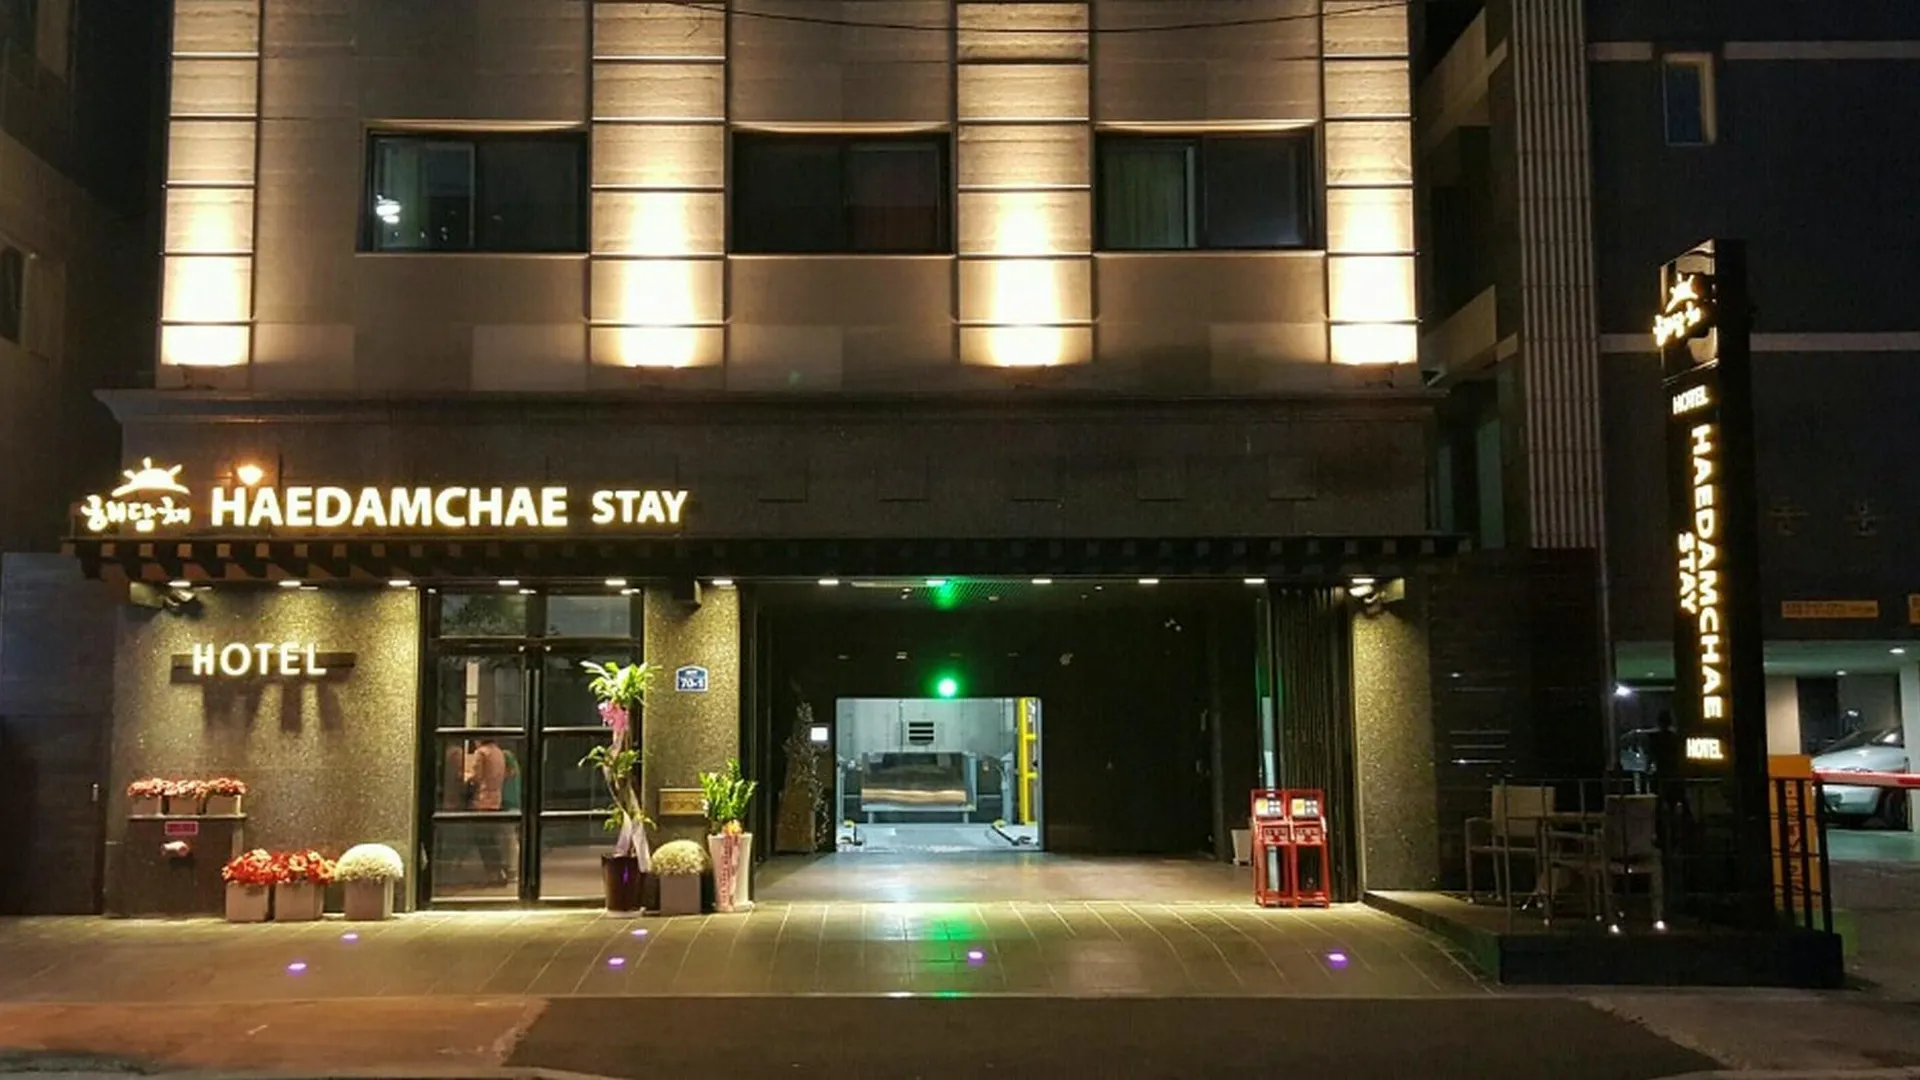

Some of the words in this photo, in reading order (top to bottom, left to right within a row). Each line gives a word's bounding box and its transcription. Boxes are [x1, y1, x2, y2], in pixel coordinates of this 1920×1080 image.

[1673, 385, 1709, 415] HOTEL
[211, 485, 568, 528] HAEDAMCHAE
[592, 490, 688, 524] STAY
[1678, 532, 1698, 614] STAY
[1691, 424, 1723, 719] HAEDAMCHAE
[192, 642, 326, 676] HOTEL
[1687, 737, 1723, 760] HOTEL
